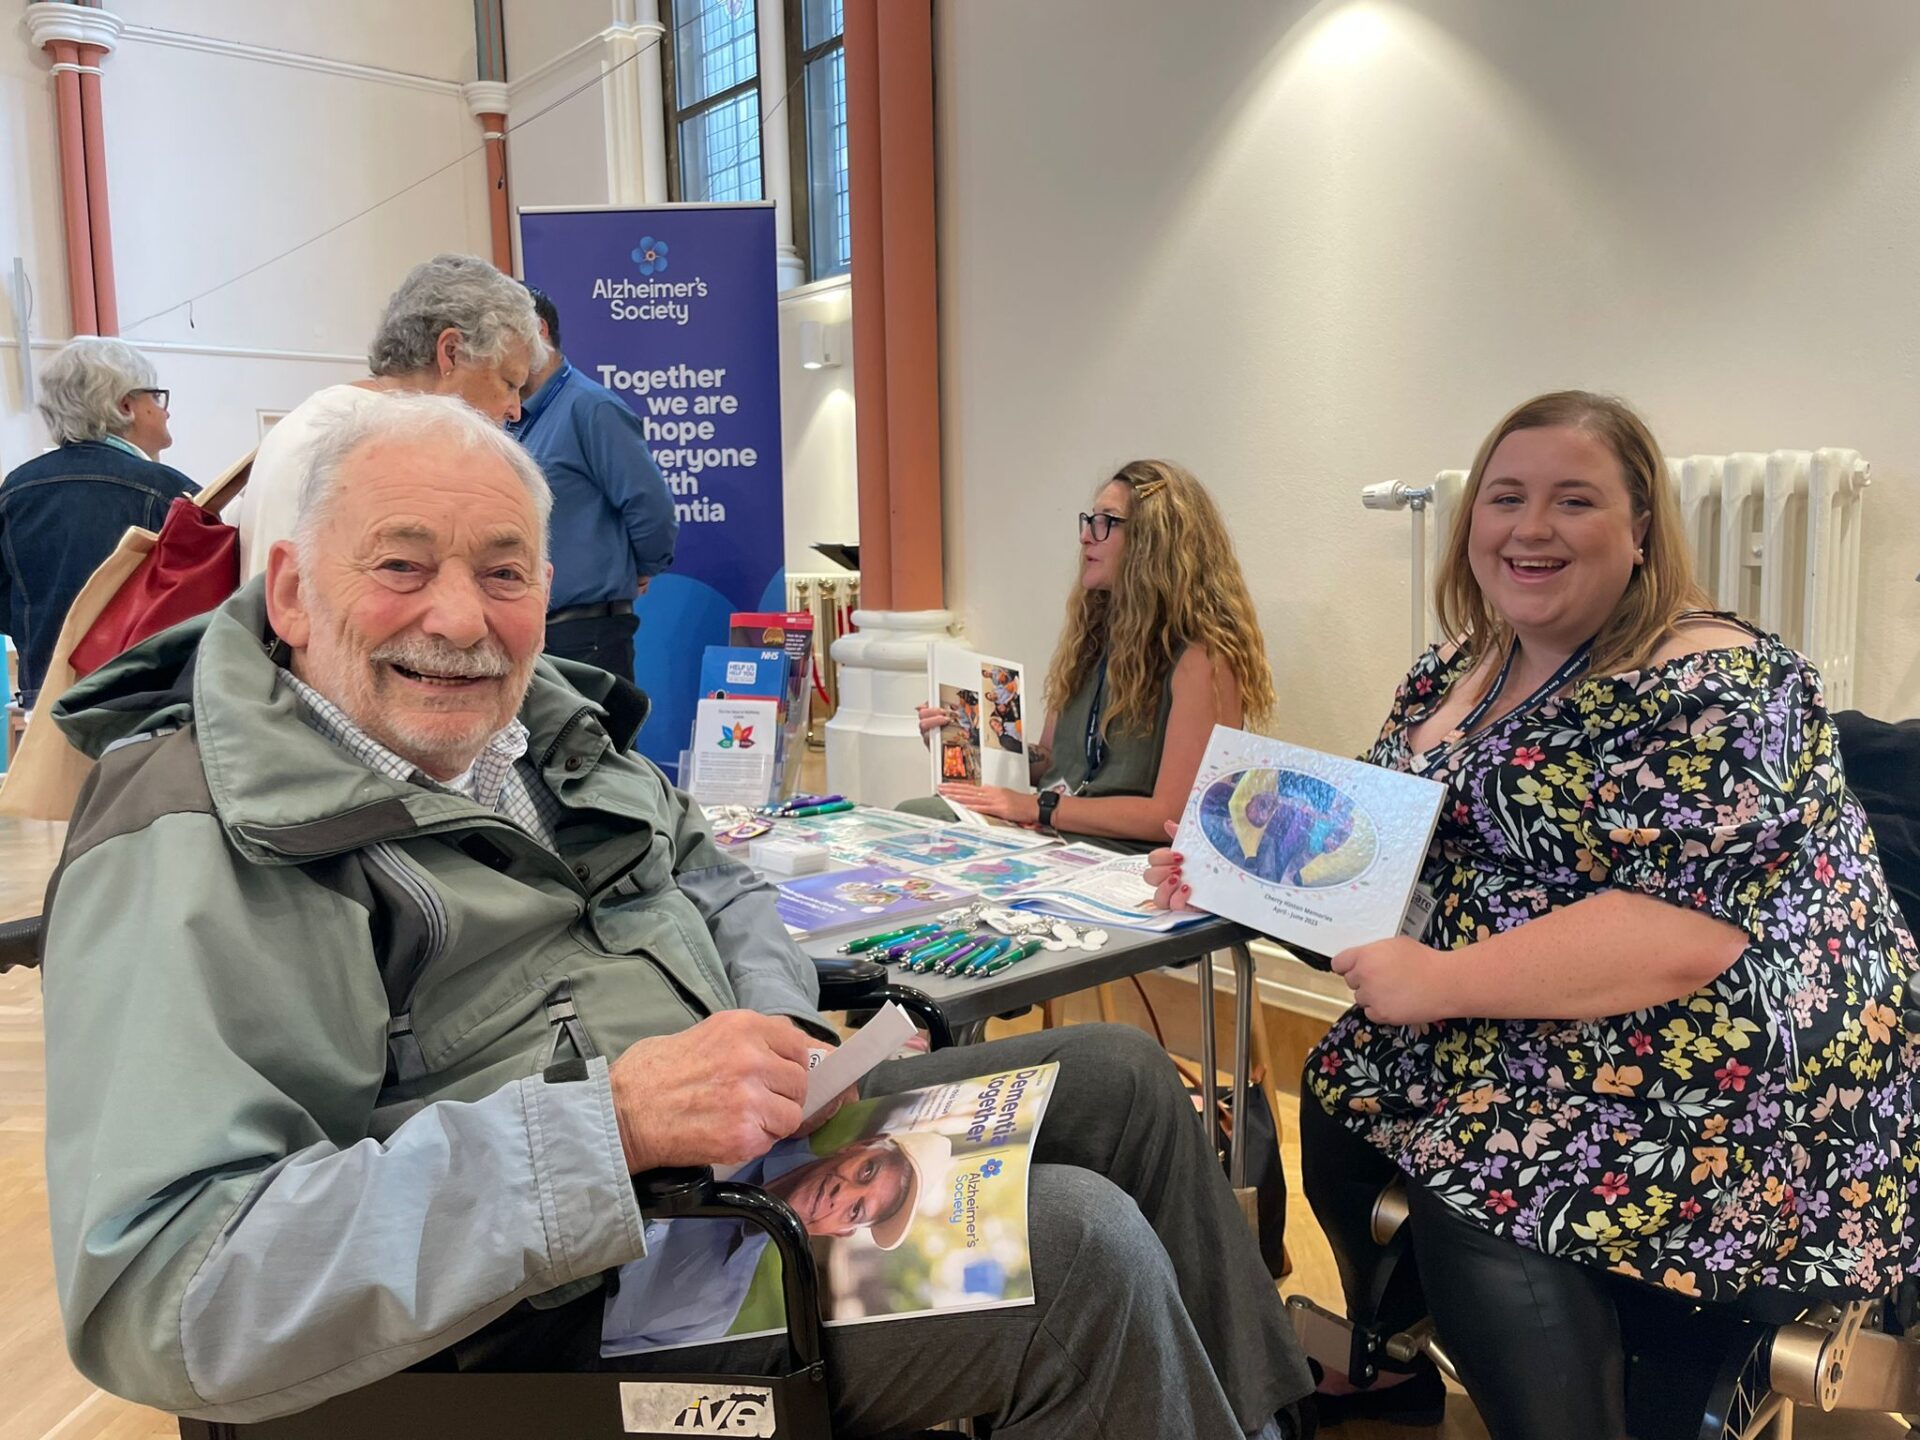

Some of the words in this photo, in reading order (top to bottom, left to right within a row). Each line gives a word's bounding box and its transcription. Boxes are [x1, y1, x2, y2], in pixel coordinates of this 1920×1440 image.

[592, 277, 708, 299] Alzheimer's
[610, 300, 689, 325] Society
[596, 363, 726, 395] Together
[646, 396, 688, 415] we
[693, 395, 738, 414] are
[643, 416, 715, 446] hope
[652, 447, 758, 473] eryone
[662, 470, 698, 495] ith
[674, 496, 726, 522] ntia
[761, 651, 779, 660] NHS
[1264, 893, 1283, 905] Cherry
[1304, 907, 1333, 922] Memories
[1411, 890, 1432, 910] are
[1273, 906, 1287, 914] April
[1290, 912, 1304, 921] June
[966, 1073, 1011, 1144] together
[989, 1069, 1038, 1147] Dementia
[949, 1174, 969, 1224] Society
[966, 1172, 981, 1248] Alzheimer's
[680, 1396, 766, 1432] ive
